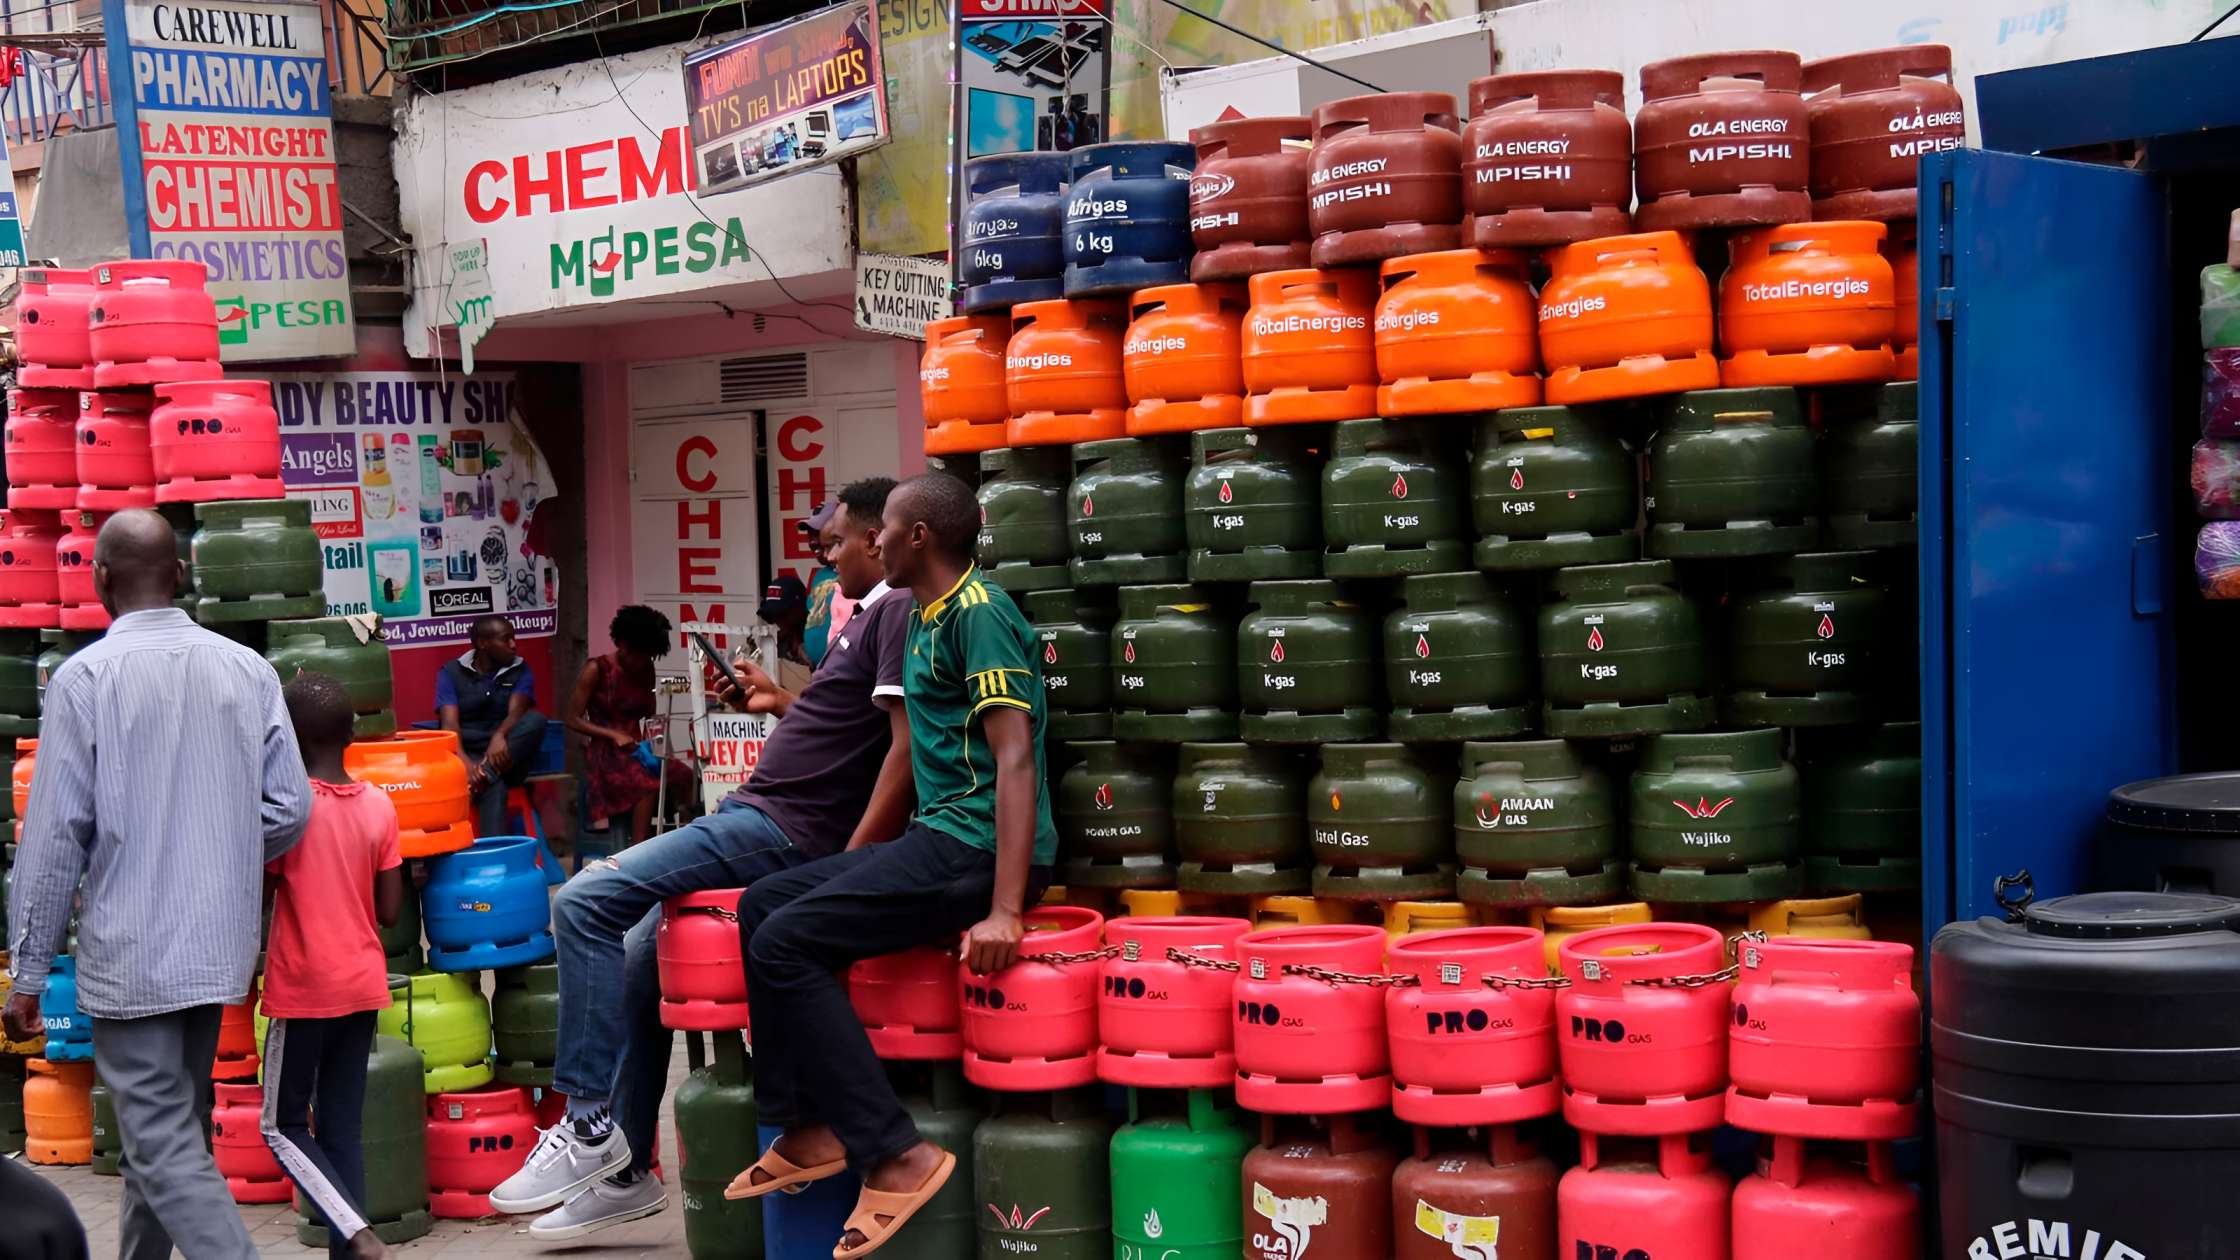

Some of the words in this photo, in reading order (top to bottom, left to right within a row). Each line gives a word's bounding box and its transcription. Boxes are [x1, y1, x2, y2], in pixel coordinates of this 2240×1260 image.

[153, 4, 297, 50] CAREWELL
[133, 51, 322, 111] PHARMACY
[699, 94, 742, 138] TV'S
[748, 95, 770, 122] na
[775, 48, 867, 112] LAPTOPS
[138, 121, 328, 158] LATENIGHT
[1688, 120, 1726, 138] OLA
[1729, 119, 1788, 134] ENERGY
[1476, 143, 1503, 159] OLA
[1506, 140, 1570, 155] ENERGY
[1688, 143, 1791, 164] MPISHI
[463, 124, 697, 224] CHEMI
[1332, 157, 1387, 180] ENERGY
[1476, 165, 1571, 184] MPISHI
[146, 165, 335, 228] CHEMIST
[1312, 182, 1391, 210] MPISHI
[1075, 236, 1083, 252] 6
[1089, 231, 1114, 253] kg
[864, 267, 890, 290] KEY
[895, 270, 945, 298] CUTTING
[1742, 276, 1869, 303] TotalEnergies
[252, 299, 346, 330] PESA
[873, 293, 940, 321] MACHINE
[1253, 315, 1366, 337] TotalEnergies
[334, 381, 454, 425] BEAUTY
[177, 418, 223, 436] PRO
[281, 442, 353, 476] Angels
[1501, 500, 1536, 515] K-gas
[1213, 514, 1244, 531] K-gas
[1384, 514, 1419, 529] K-gas
[1807, 651, 1845, 667] K-gas
[1264, 673, 1296, 690] K-gas
[1409, 669, 1441, 687] K-gas
[1580, 663, 1618, 680] K-gas
[713, 721, 766, 738] MACHINE
[1500, 797, 1554, 812] AMAAN
[1505, 814, 1528, 826] GAS
[1341, 831, 1370, 847] Gas
[1681, 831, 1732, 847] Wajiko
[964, 983, 1006, 1010] PRO
[1104, 975, 1146, 999] PRO
[1238, 999, 1280, 1026] PRO
[1426, 1008, 1489, 1035] PRO
[1571, 1015, 1625, 1043] PRO
[469, 1134, 514, 1153] PRO
[1000, 1238, 1038, 1253] Wajiko
[1252, 1233, 1288, 1254] OLA
